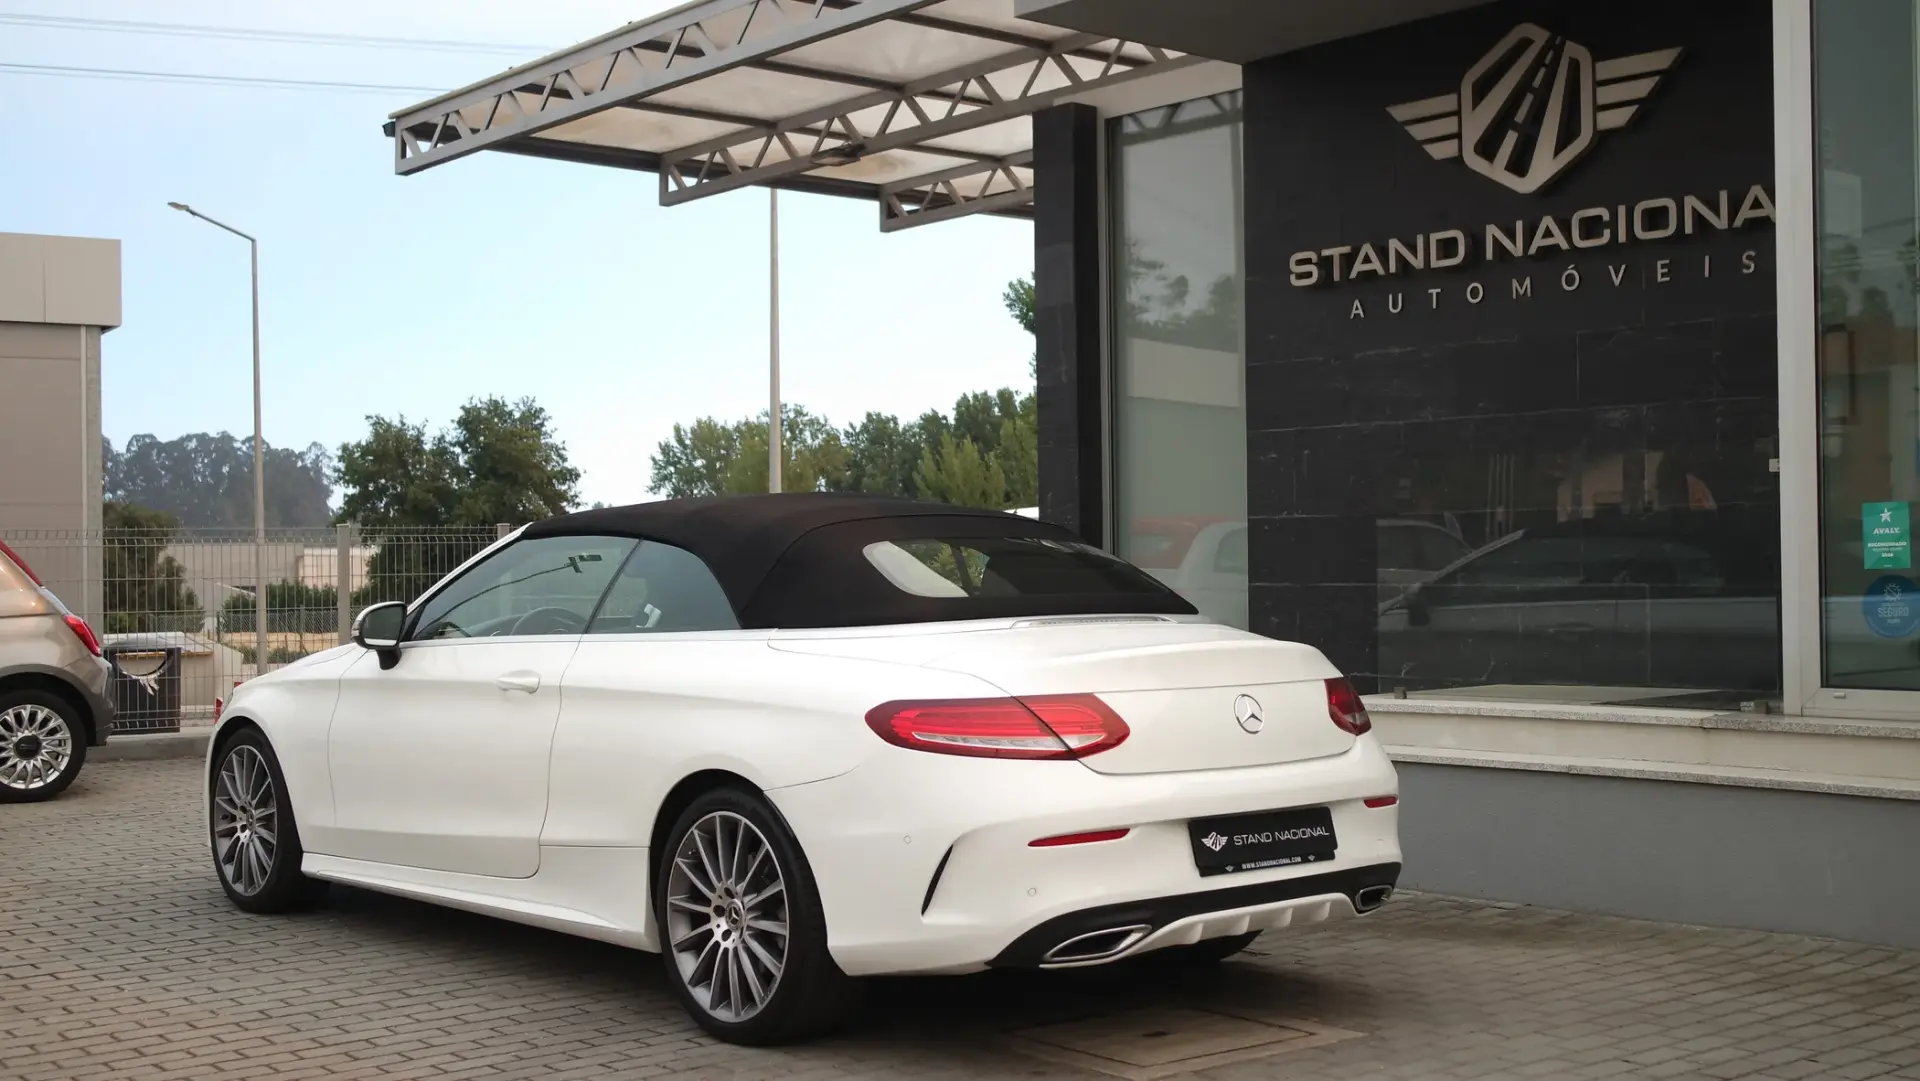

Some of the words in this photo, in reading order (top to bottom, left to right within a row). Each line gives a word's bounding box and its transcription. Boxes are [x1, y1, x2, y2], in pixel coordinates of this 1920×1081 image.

[1289, 229, 1466, 287] STAND
[1350, 250, 1756, 320] AUTOMÓVEIS
[1233, 832, 1272, 846] STAND
[1275, 826, 1330, 841] NACIONAL
